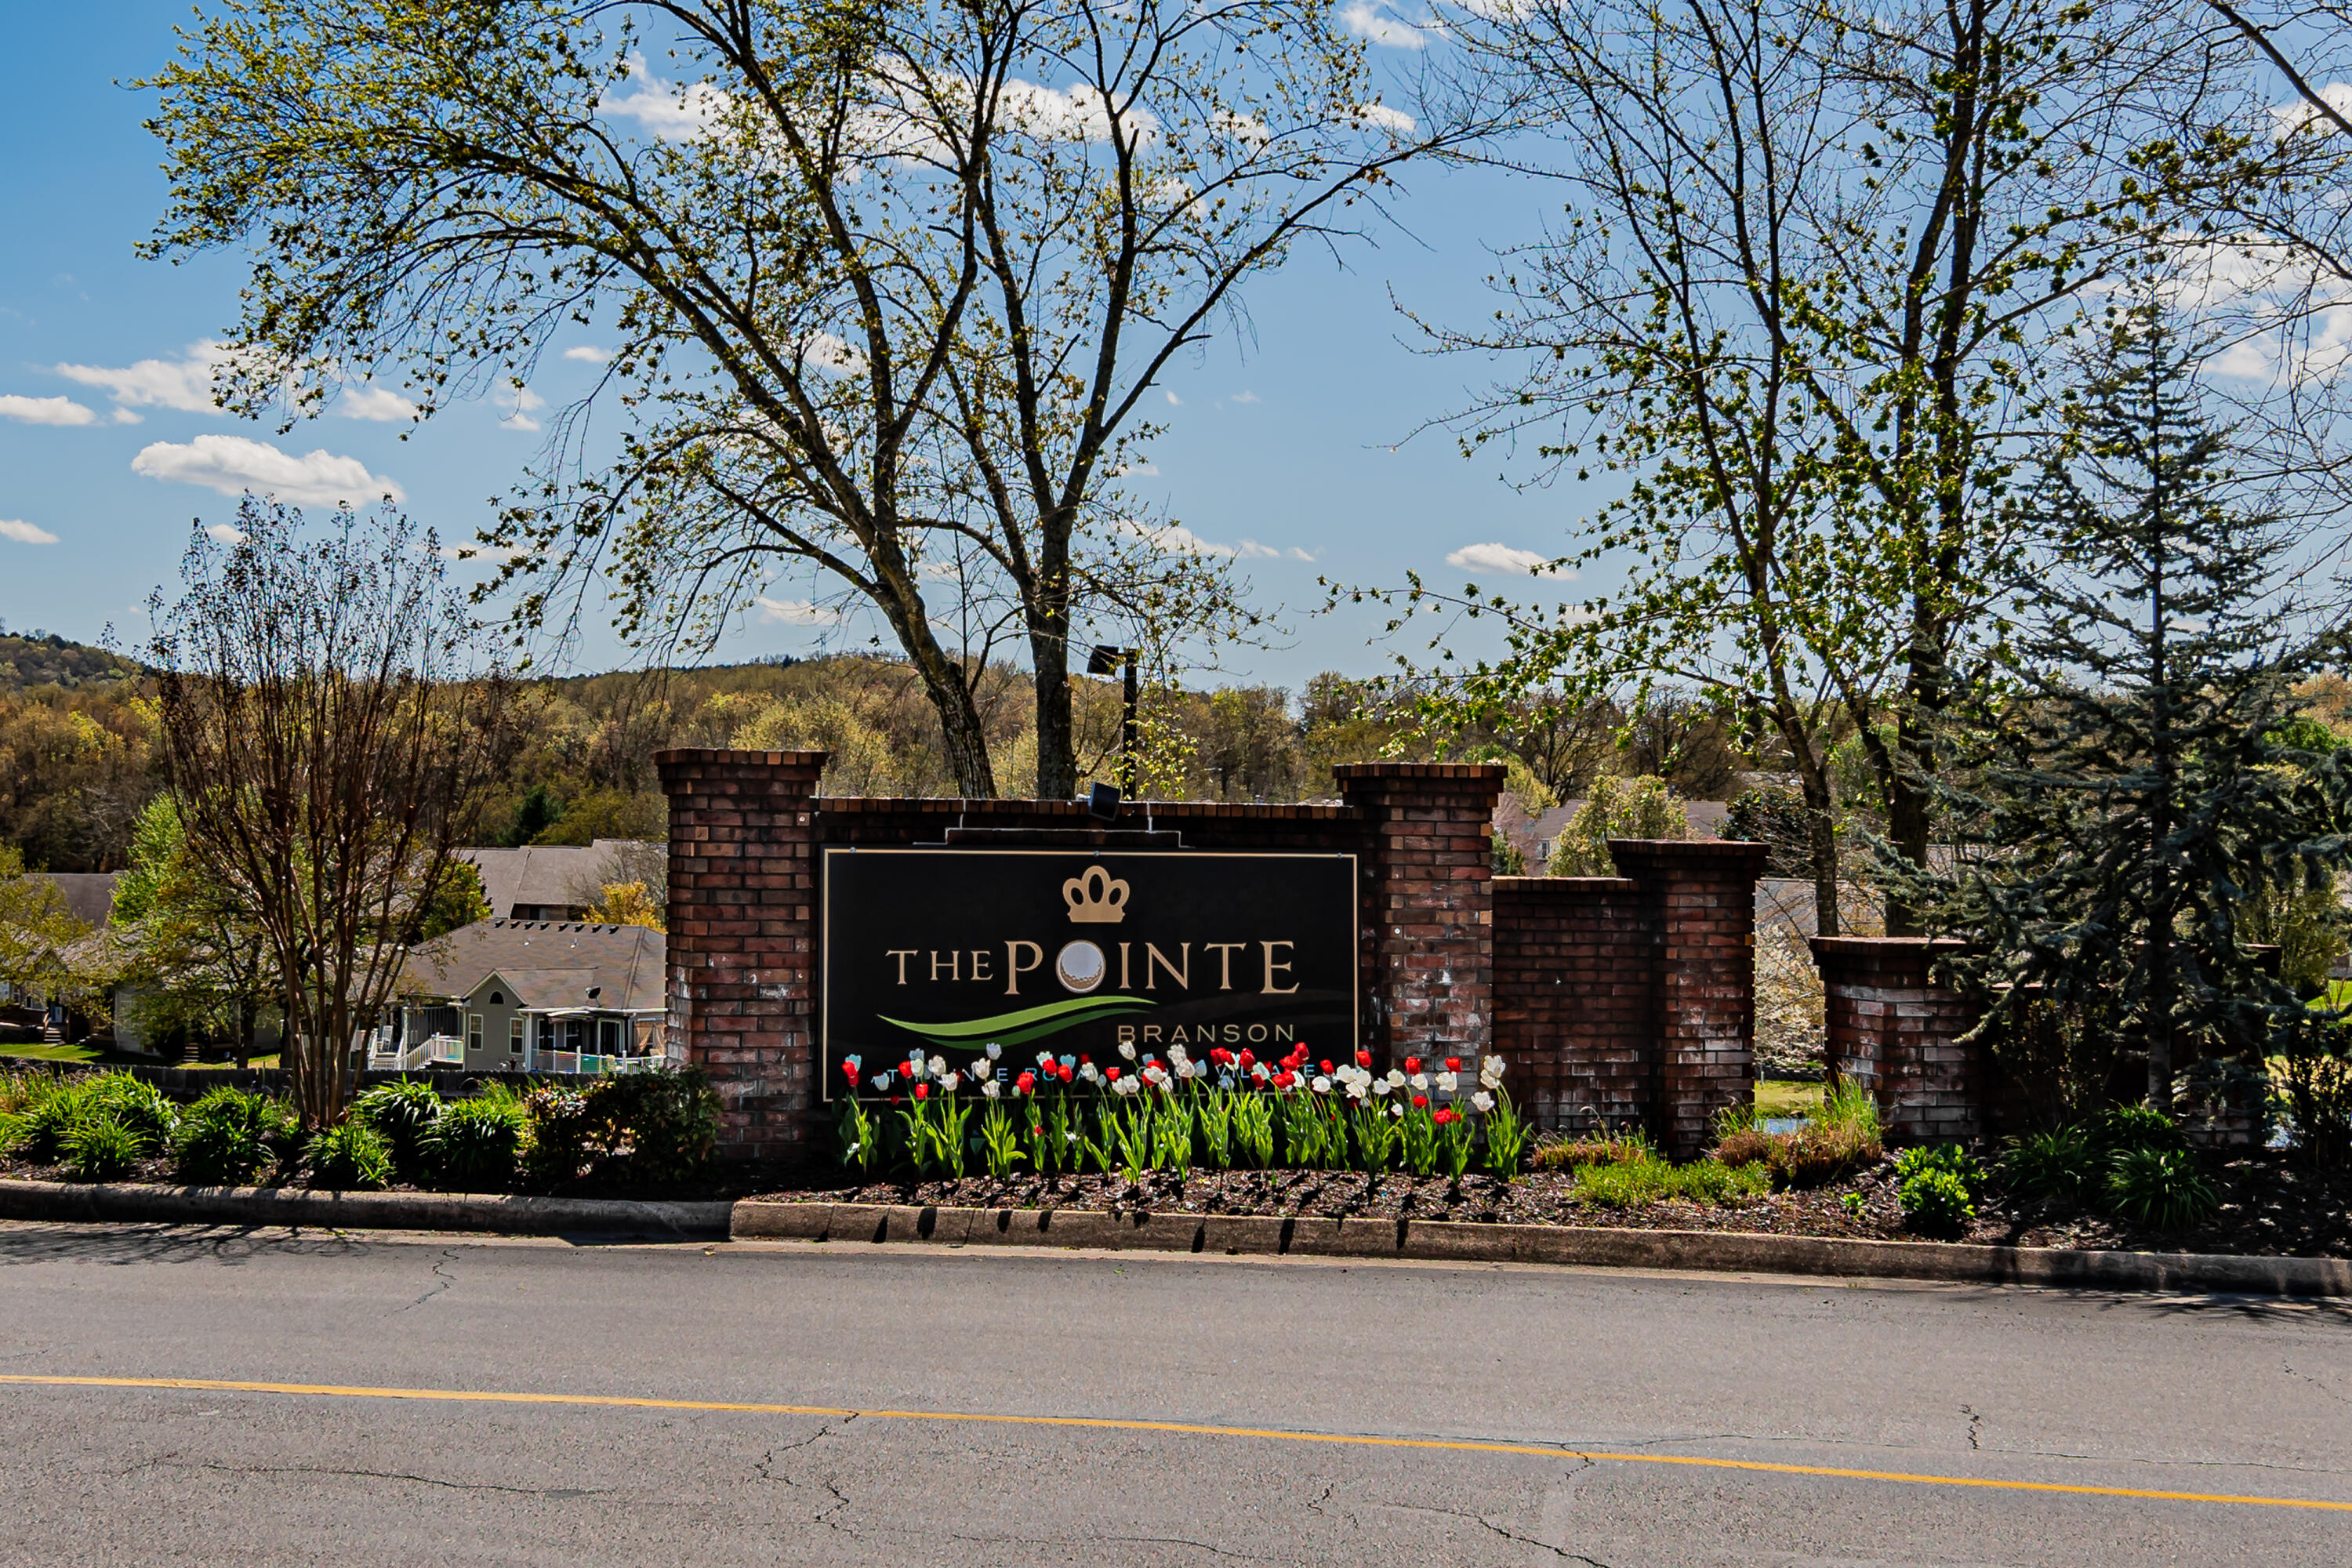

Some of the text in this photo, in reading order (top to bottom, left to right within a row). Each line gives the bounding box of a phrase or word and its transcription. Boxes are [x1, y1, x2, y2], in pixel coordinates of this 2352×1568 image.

[884, 939, 1301, 995] THE POINTE
[1117, 1023, 1294, 1044] BRANSON
